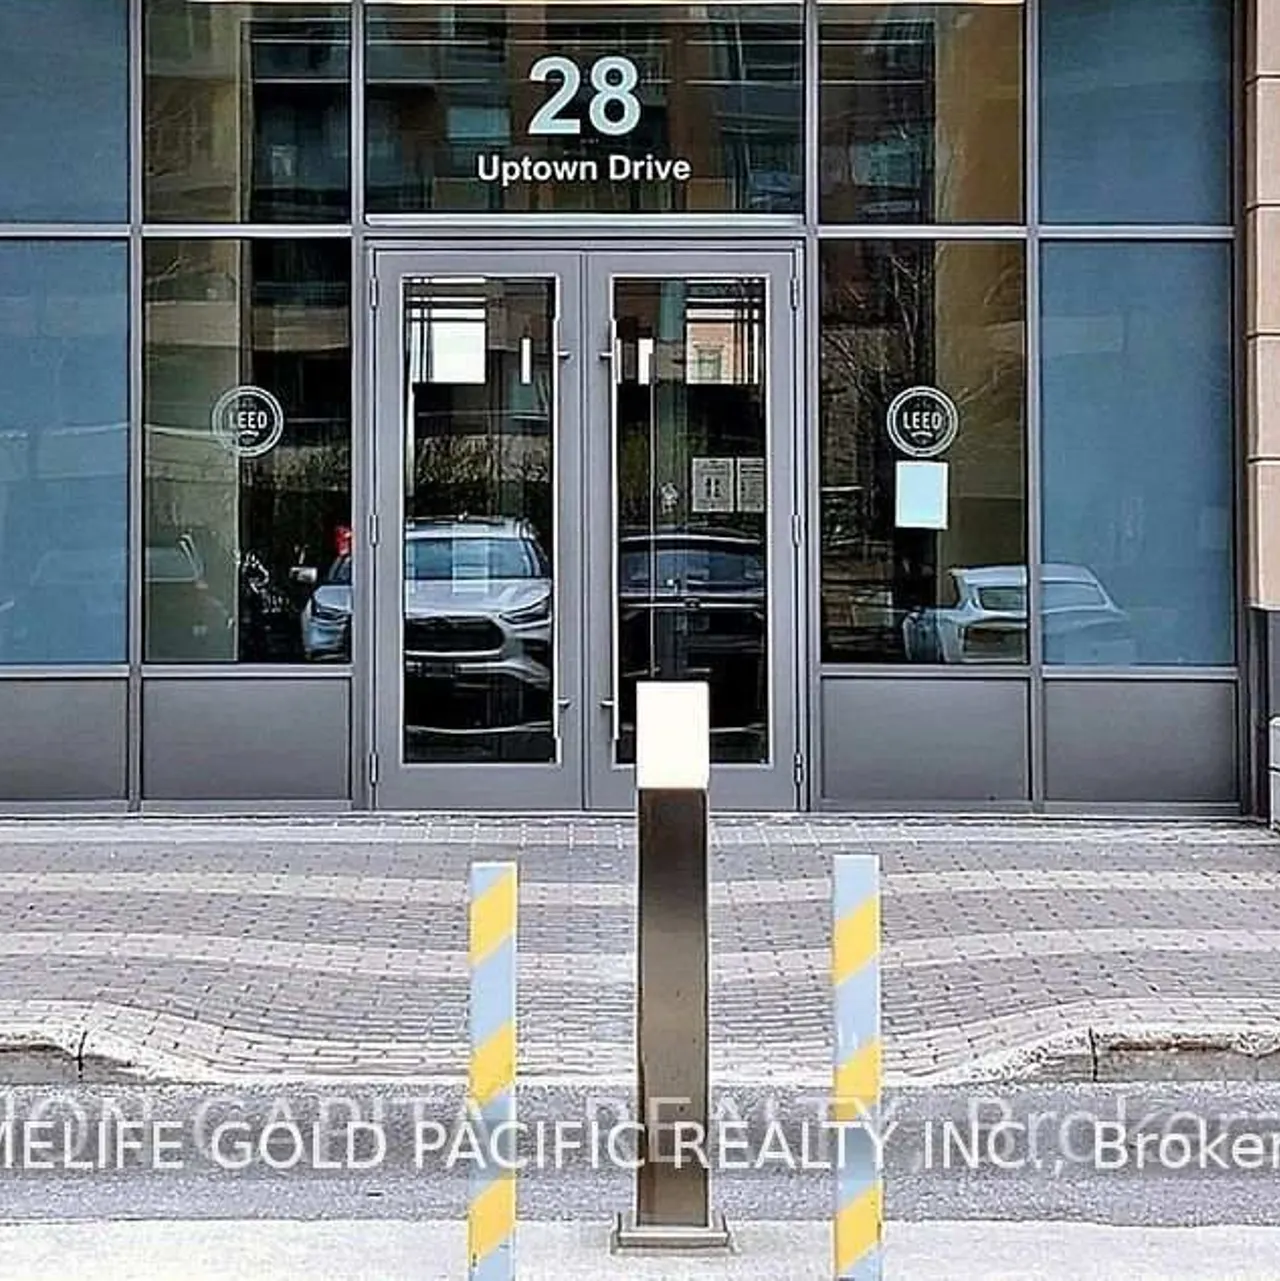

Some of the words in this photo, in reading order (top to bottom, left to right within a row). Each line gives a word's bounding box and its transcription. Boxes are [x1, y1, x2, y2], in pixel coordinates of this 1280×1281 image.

[528, 55, 642, 136] 28
[477, 153, 598, 187] Uptown
[608, 153, 692, 181] Drive
[228, 410, 268, 430] LEED
